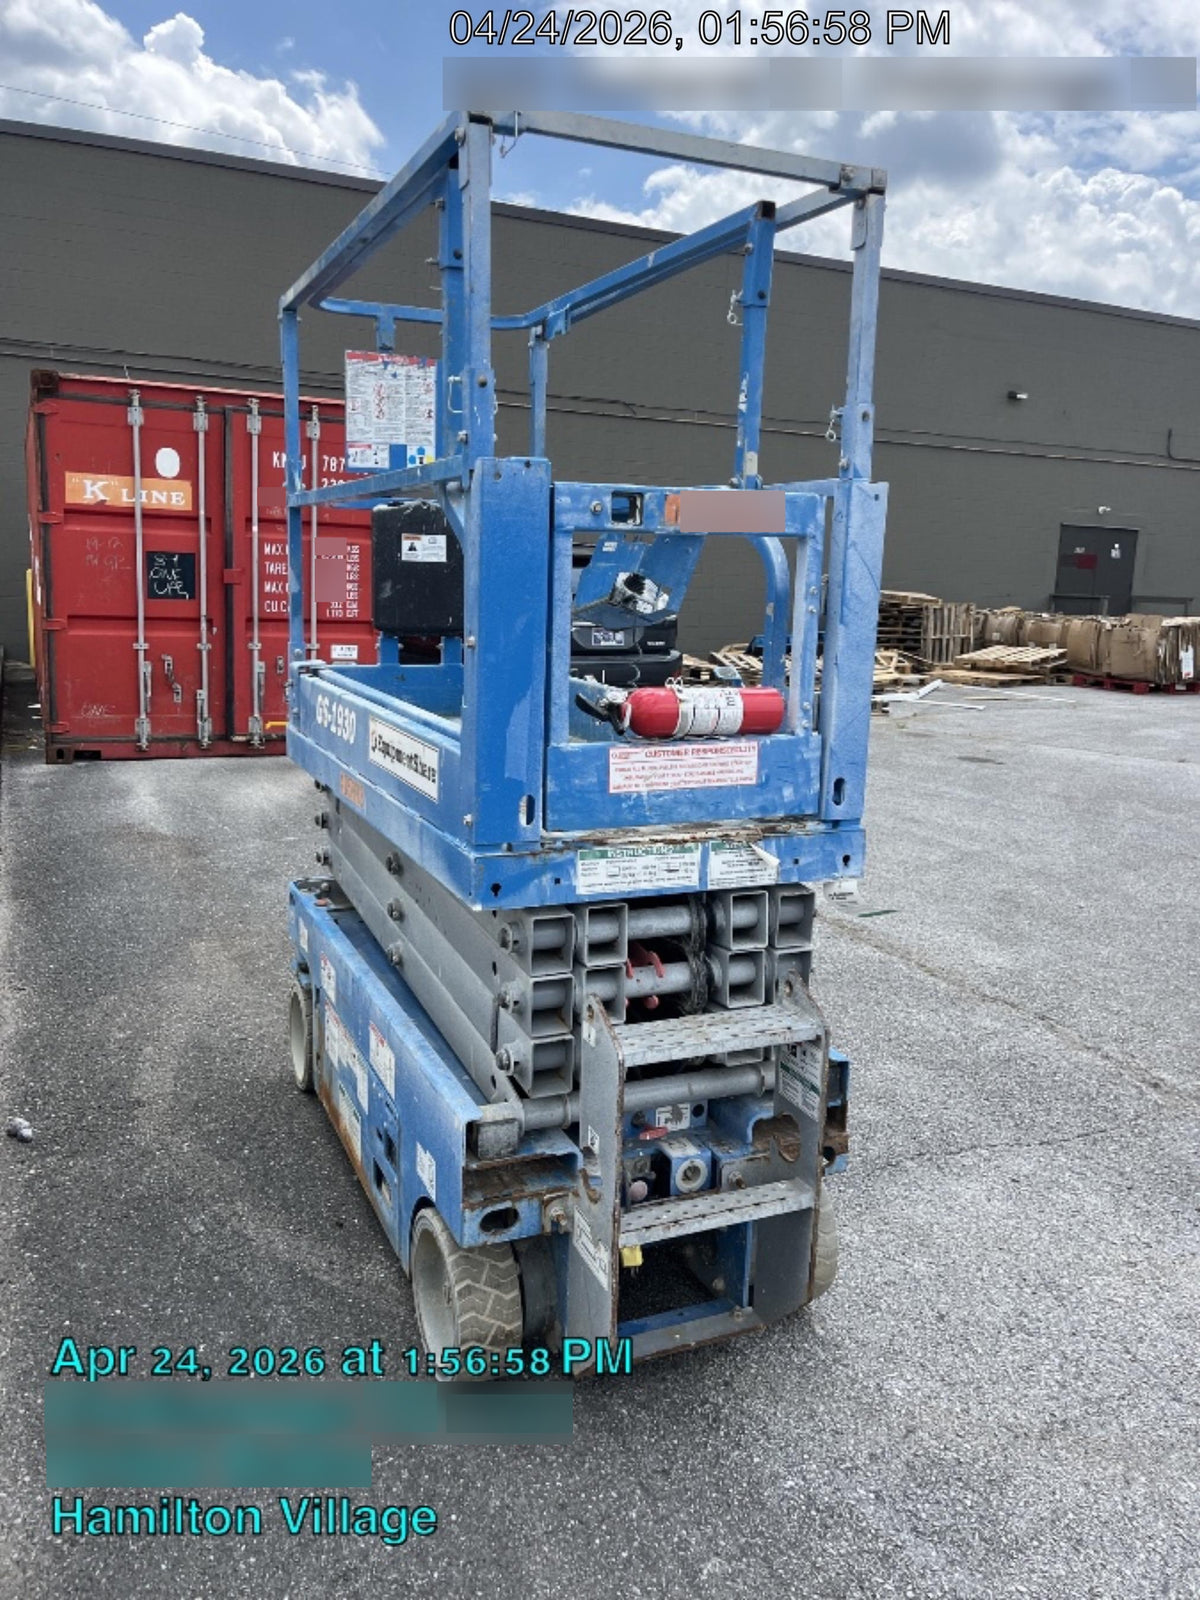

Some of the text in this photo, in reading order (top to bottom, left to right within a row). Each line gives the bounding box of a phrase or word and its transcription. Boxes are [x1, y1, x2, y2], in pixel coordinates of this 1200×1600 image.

[121, 488, 186, 506] LINE
[264, 561, 288, 575] TARE
[316, 694, 356, 744] GS-1930
